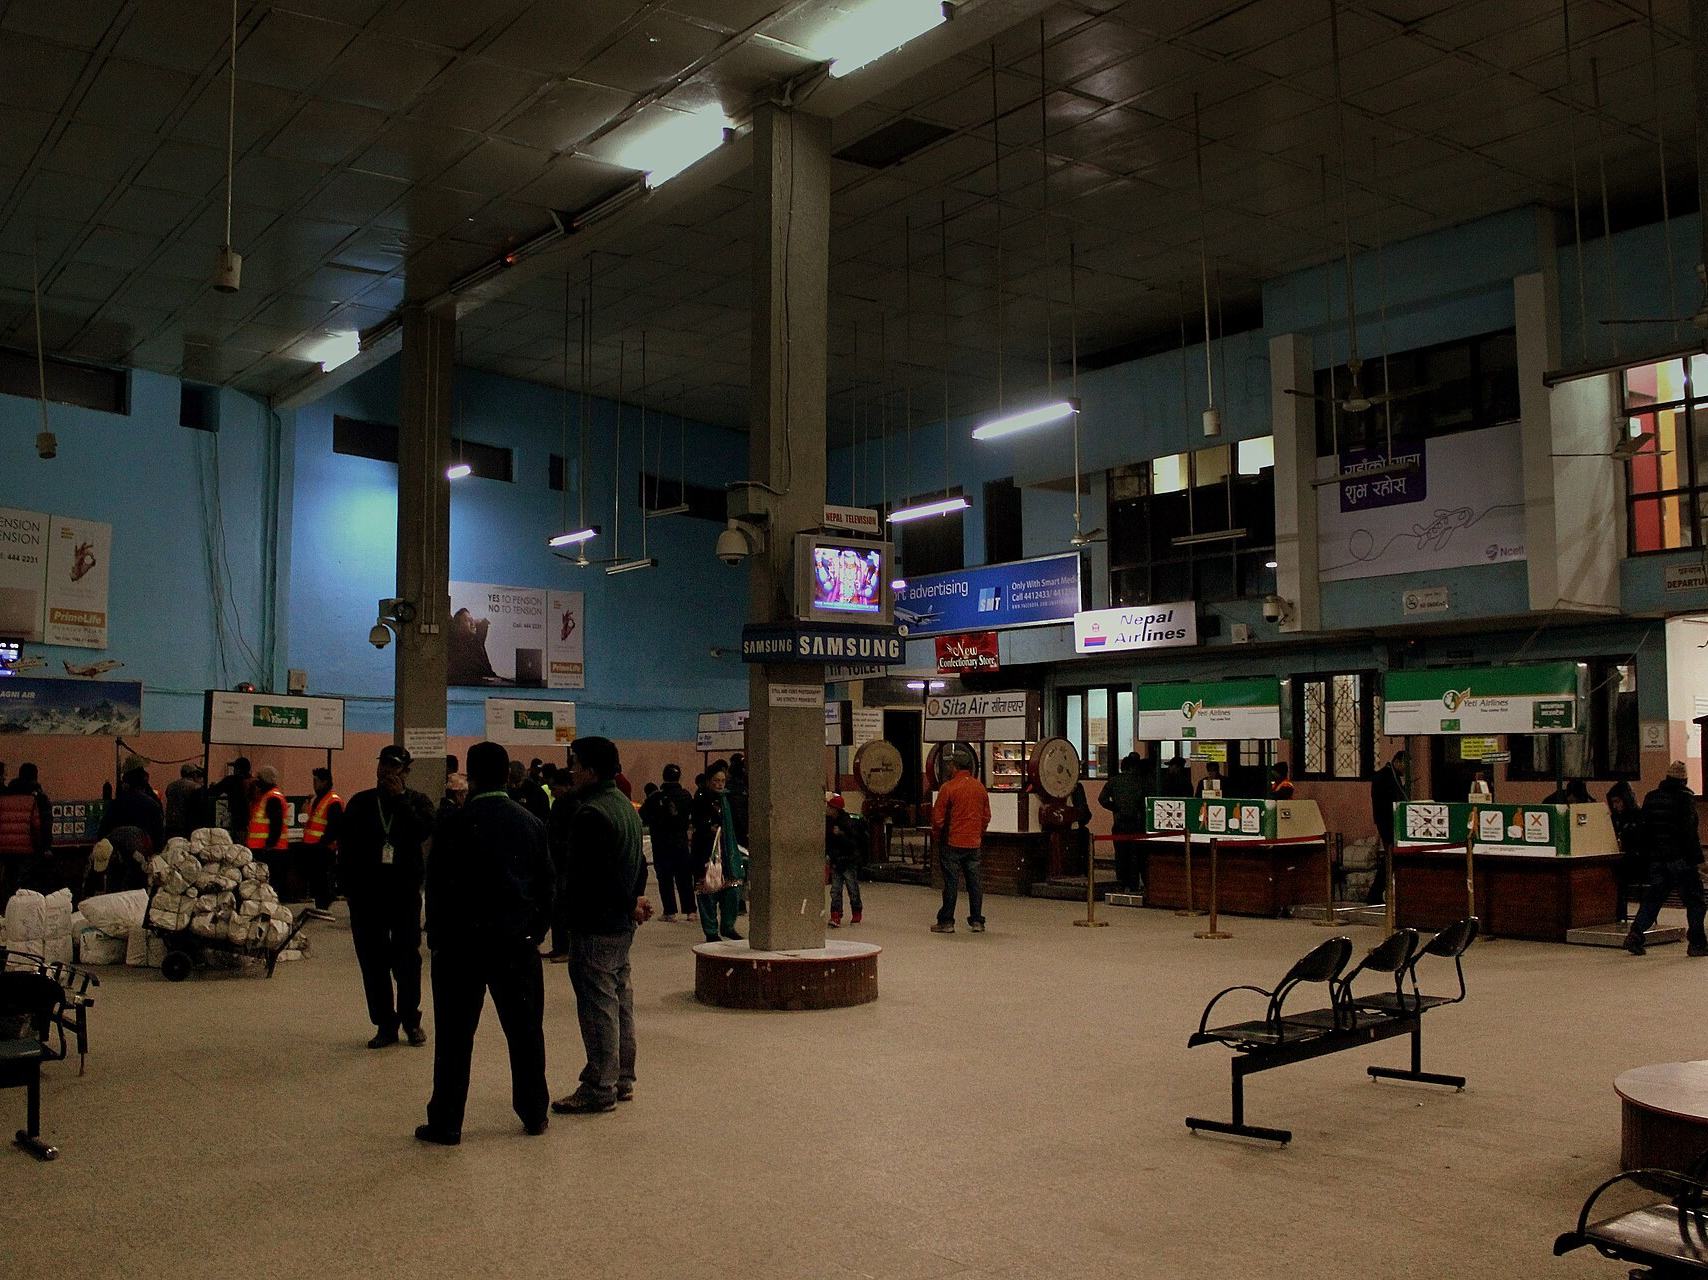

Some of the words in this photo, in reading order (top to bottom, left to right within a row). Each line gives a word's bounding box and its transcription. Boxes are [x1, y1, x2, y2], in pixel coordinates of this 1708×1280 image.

[1345, 484, 1368, 504] शुभ
[825, 512, 843, 523] NEPAL
[845, 514, 877, 525] TELEVISION
[1500, 545, 1524, 556] Ncell
[909, 579, 968, 600] advertising
[1012, 582, 1026, 591] Only
[1026, 579, 1040, 588] With
[1041, 578, 1060, 587] Smart
[487, 593, 500, 602] YES
[502, 595, 511, 603] TO
[512, 595, 542, 606] PENSION
[1011, 592, 1023, 602] Call
[488, 604, 500, 613] NO
[501, 605, 512, 614] TO
[1120, 610, 1173, 627] Nepal
[1114, 626, 1186, 644] Airlines
[743, 638, 793, 655] SAMSUNG
[799, 635, 900, 658] SAMSUNG
[952, 639, 978, 657] New
[939, 657, 978, 669] Confectionary
[978, 654, 995, 666] Store
[848, 663, 882, 676] TOILET
[0, 690, 20, 699] AGNI
[22, 691, 36, 699] AIR
[942, 698, 967, 716] Sita
[968, 697, 989, 715] Air
[1464, 699, 1478, 707] Yeti
[1480, 698, 1509, 707] Airlines
